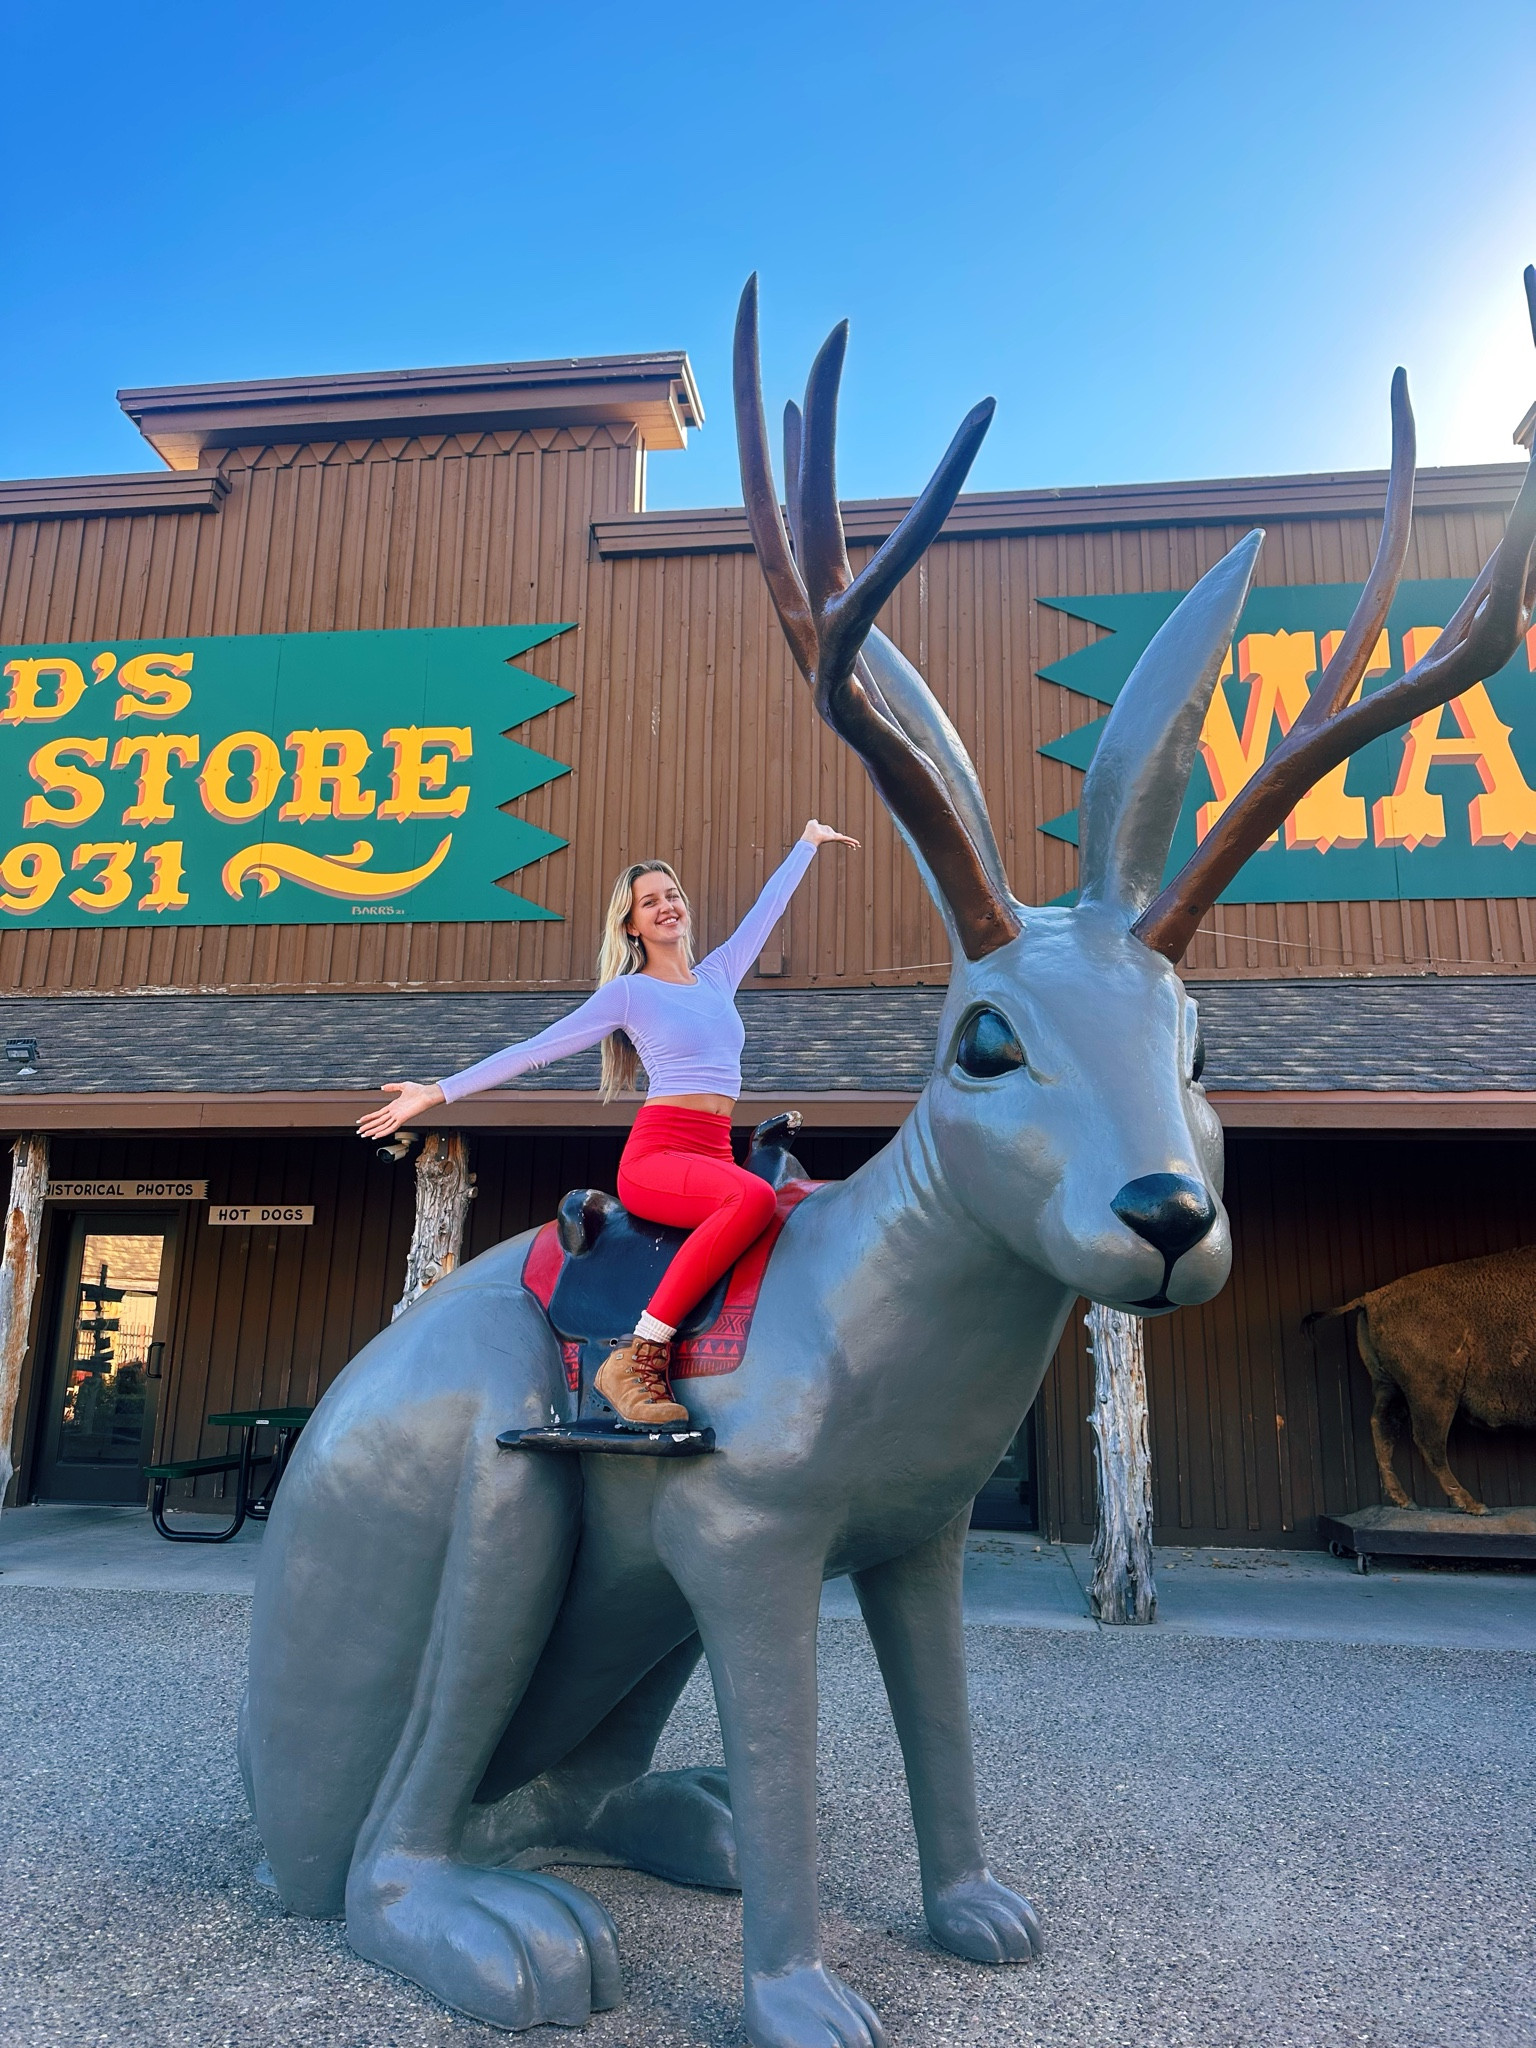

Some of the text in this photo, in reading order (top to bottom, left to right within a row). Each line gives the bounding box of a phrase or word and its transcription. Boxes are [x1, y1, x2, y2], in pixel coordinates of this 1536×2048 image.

[0, 652, 194, 727] D'S
[23, 725, 473, 829] STORE
[1196, 626, 1536, 854] WA
[0, 839, 190, 914] 931
[136, 1183, 194, 1197] PHOTOS
[218, 1208, 304, 1221] HOT DOGS
